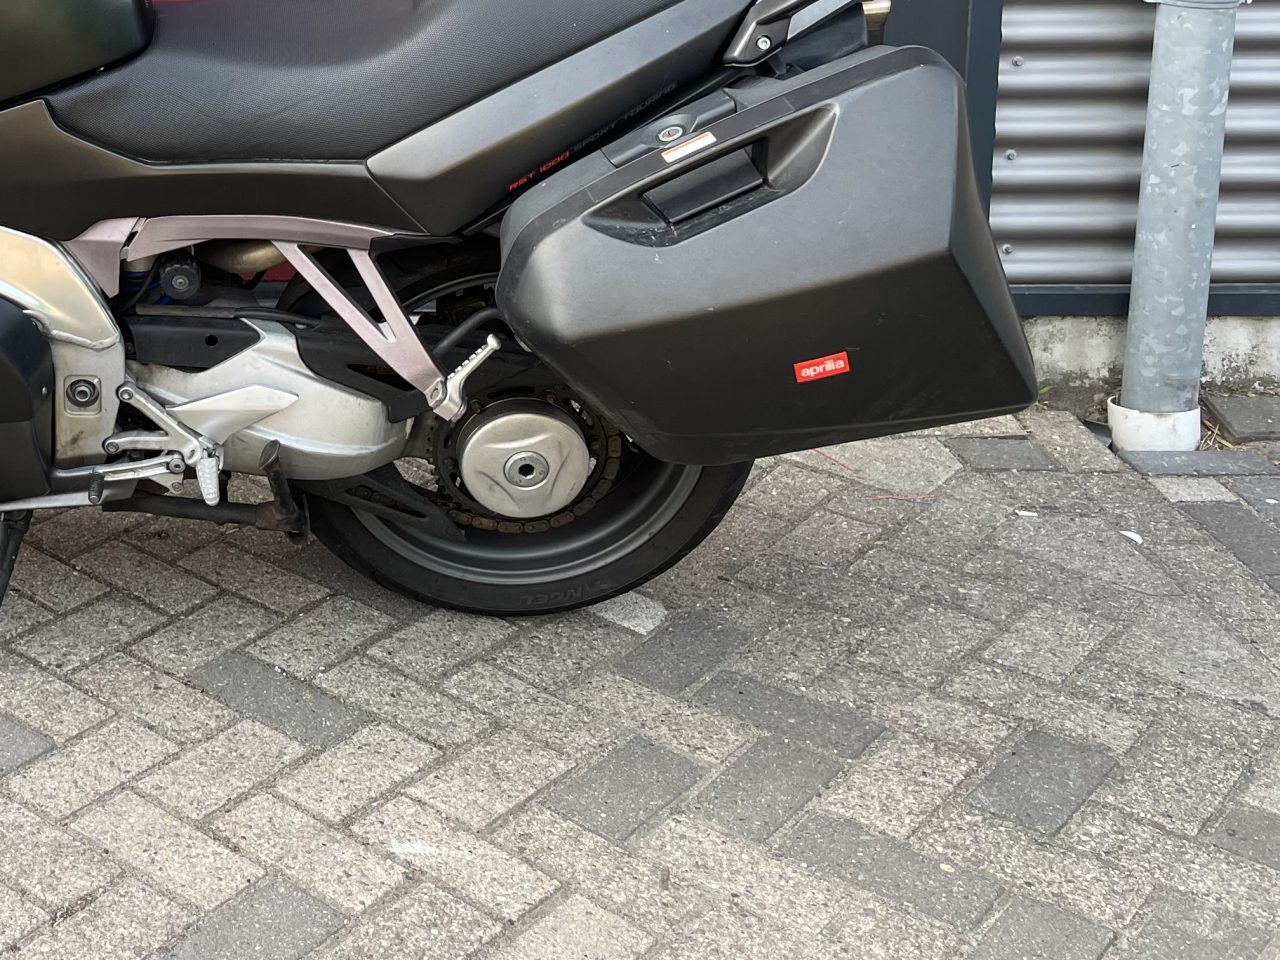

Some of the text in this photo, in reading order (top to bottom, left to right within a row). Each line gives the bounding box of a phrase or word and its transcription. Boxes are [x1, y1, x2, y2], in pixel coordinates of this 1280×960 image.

[508, 169, 536, 191] RST
[539, 151, 570, 173] 1000
[800, 359, 845, 377] aprilia
